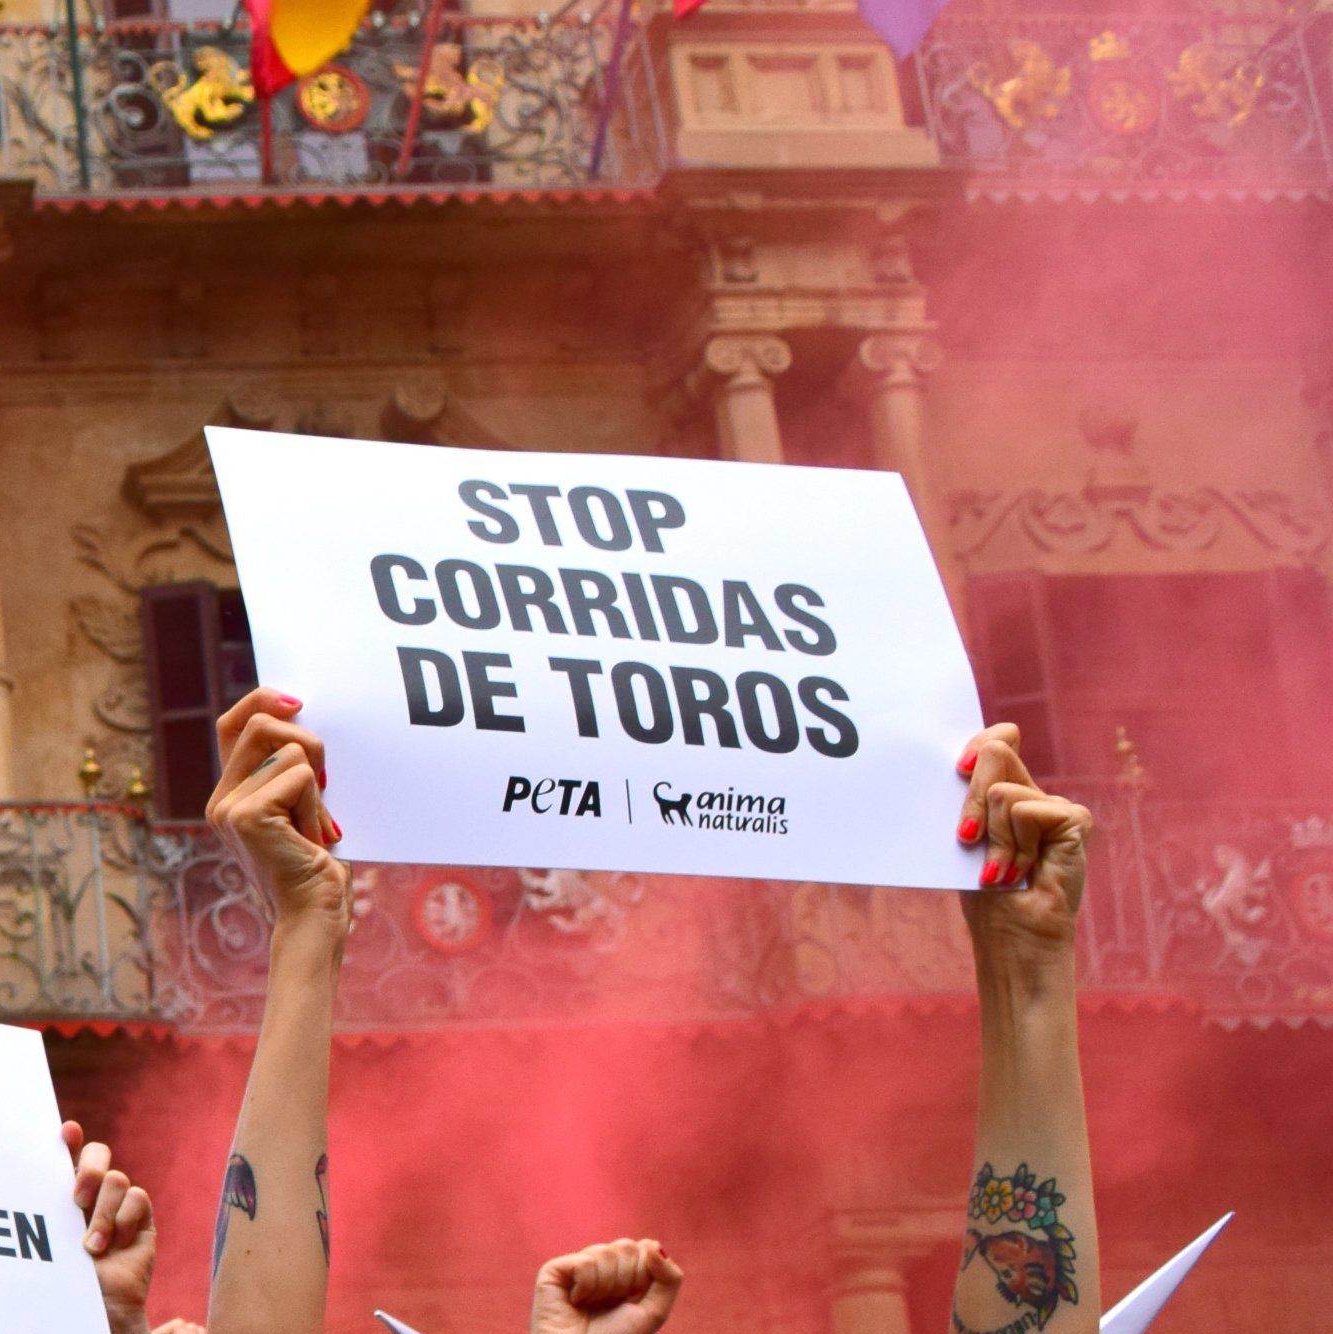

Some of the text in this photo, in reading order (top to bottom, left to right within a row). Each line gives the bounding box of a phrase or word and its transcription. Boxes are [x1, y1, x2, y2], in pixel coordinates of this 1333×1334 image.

[458, 480, 685, 553] STOP
[370, 554, 837, 656] CORRIDAS
[397, 646, 859, 759] DE TOROS
[695, 787, 786, 816] anima
[697, 811, 788, 836] naturalis
